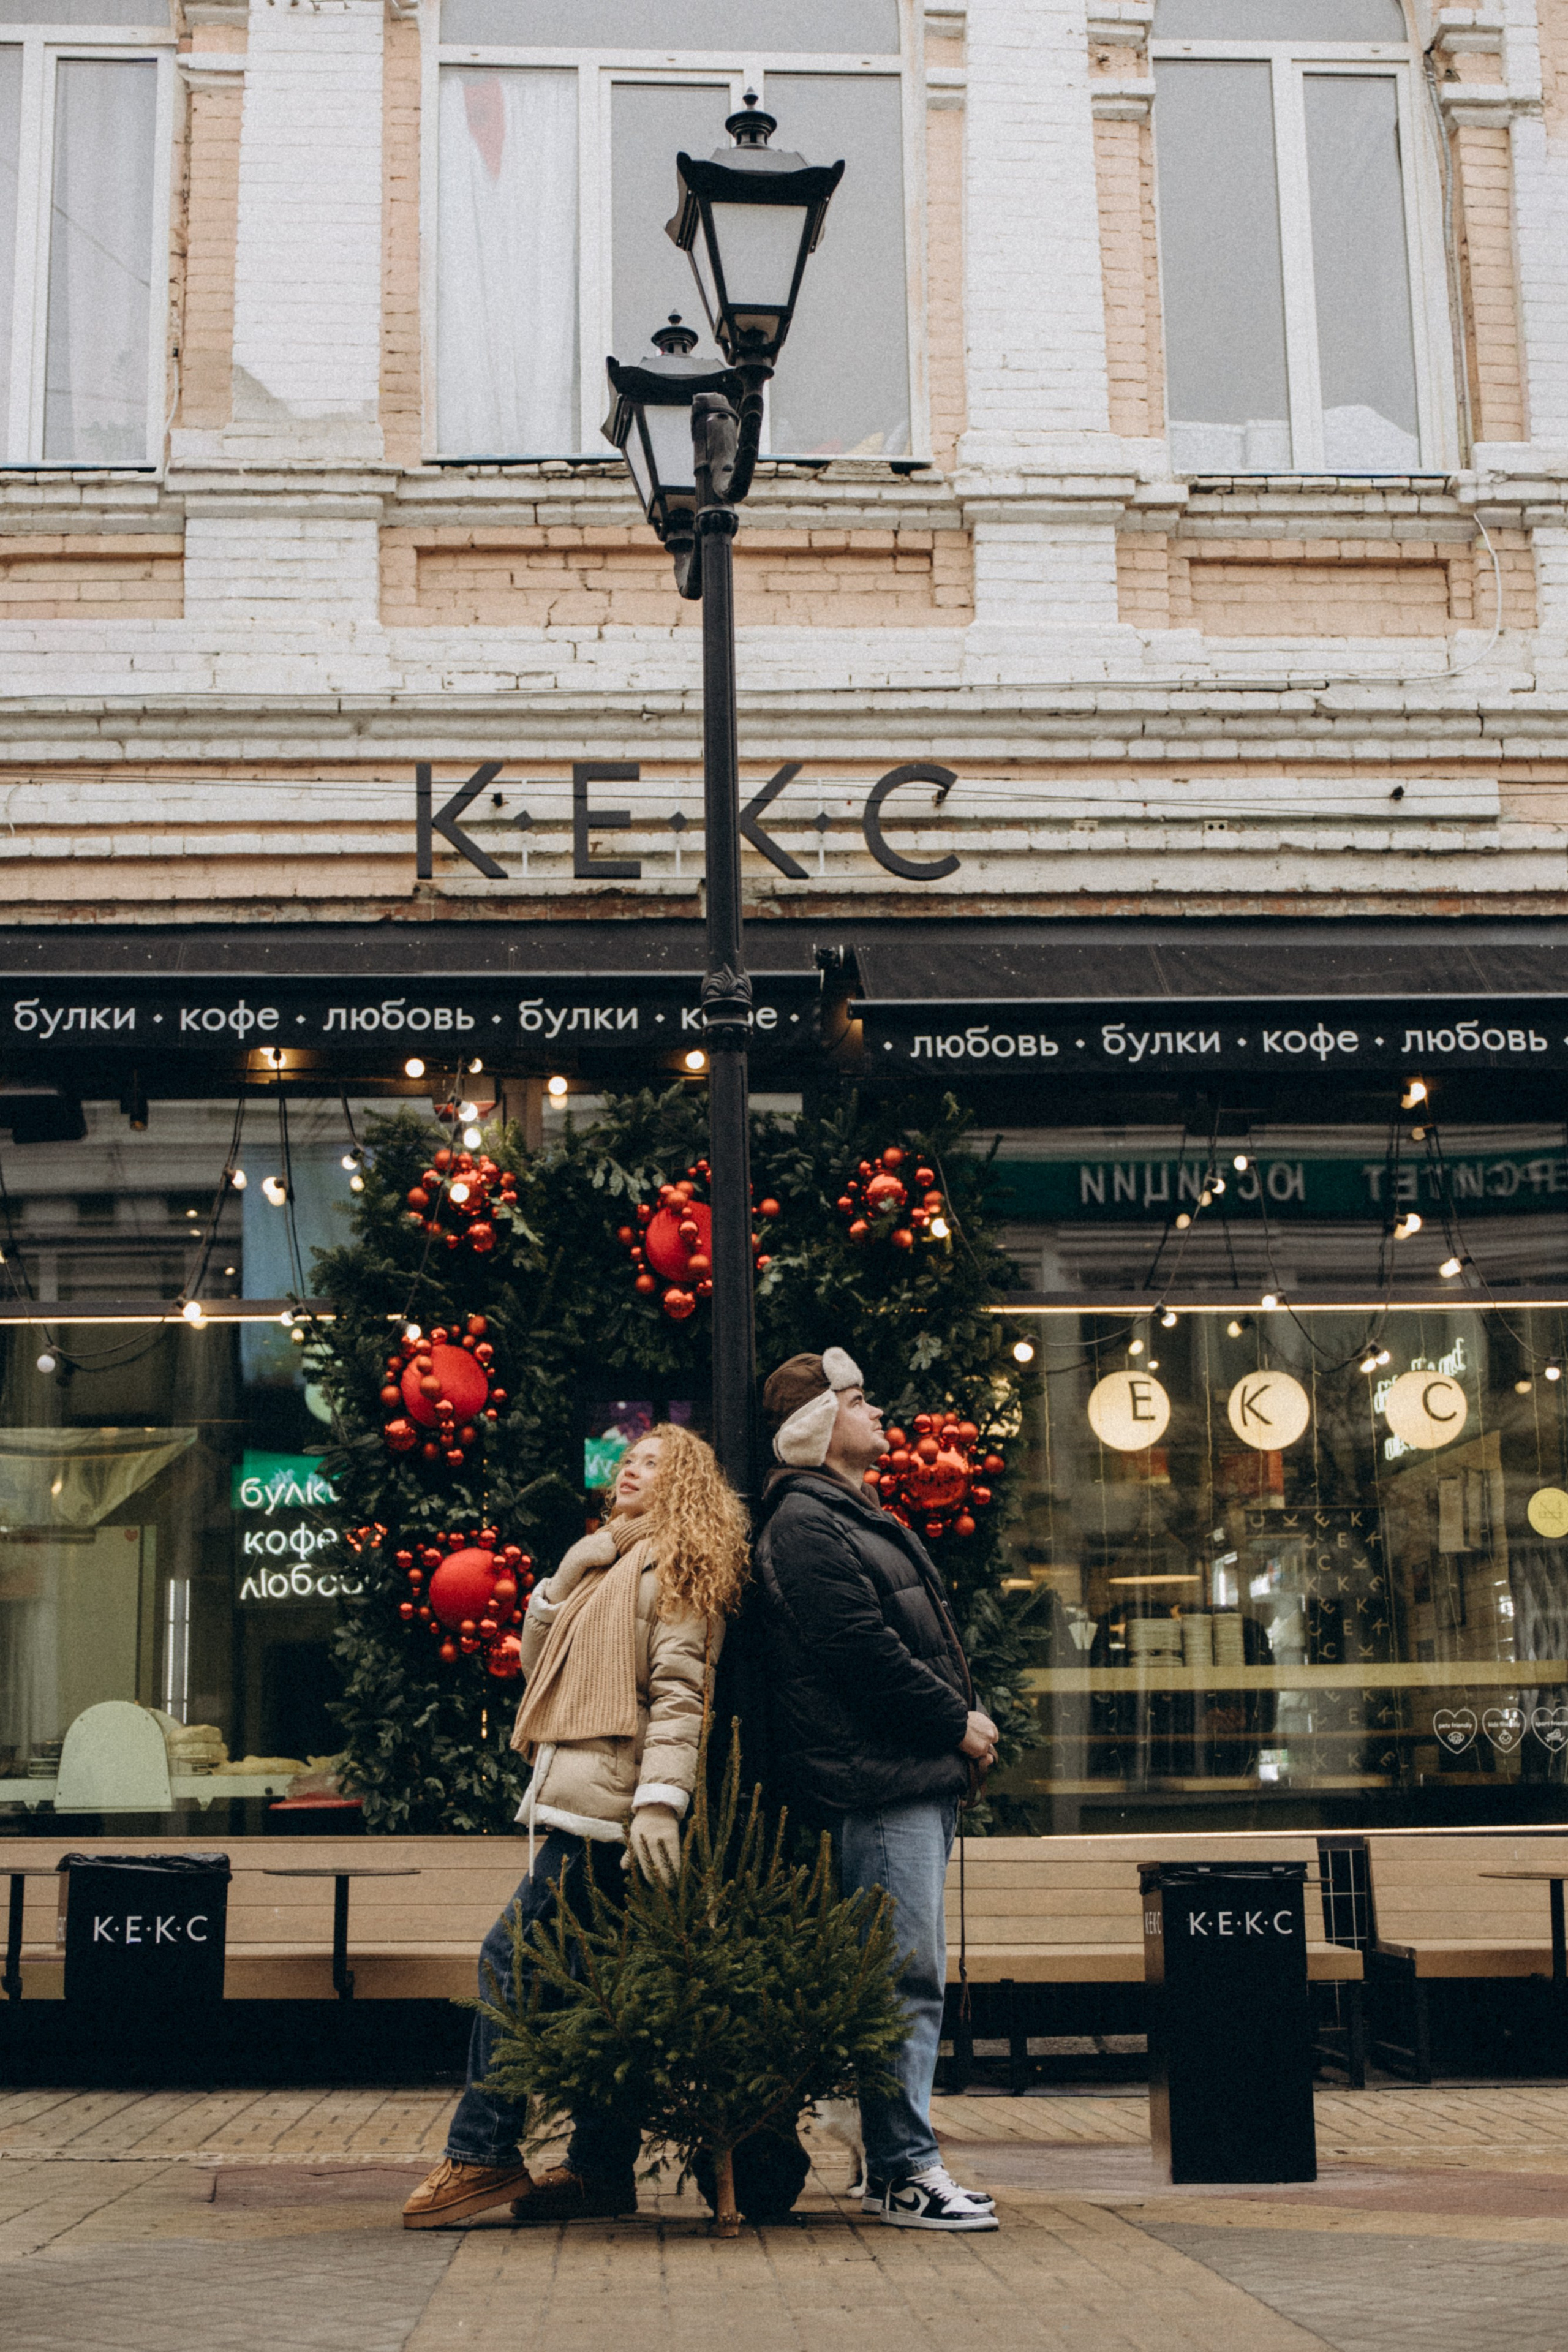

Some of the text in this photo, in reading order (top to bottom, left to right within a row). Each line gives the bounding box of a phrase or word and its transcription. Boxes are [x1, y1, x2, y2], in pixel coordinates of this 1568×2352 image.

[13, 998, 778, 1039] булки кофе любовь булки ке
[910, 1020, 1548, 1062] любовь булки кофе любовь
